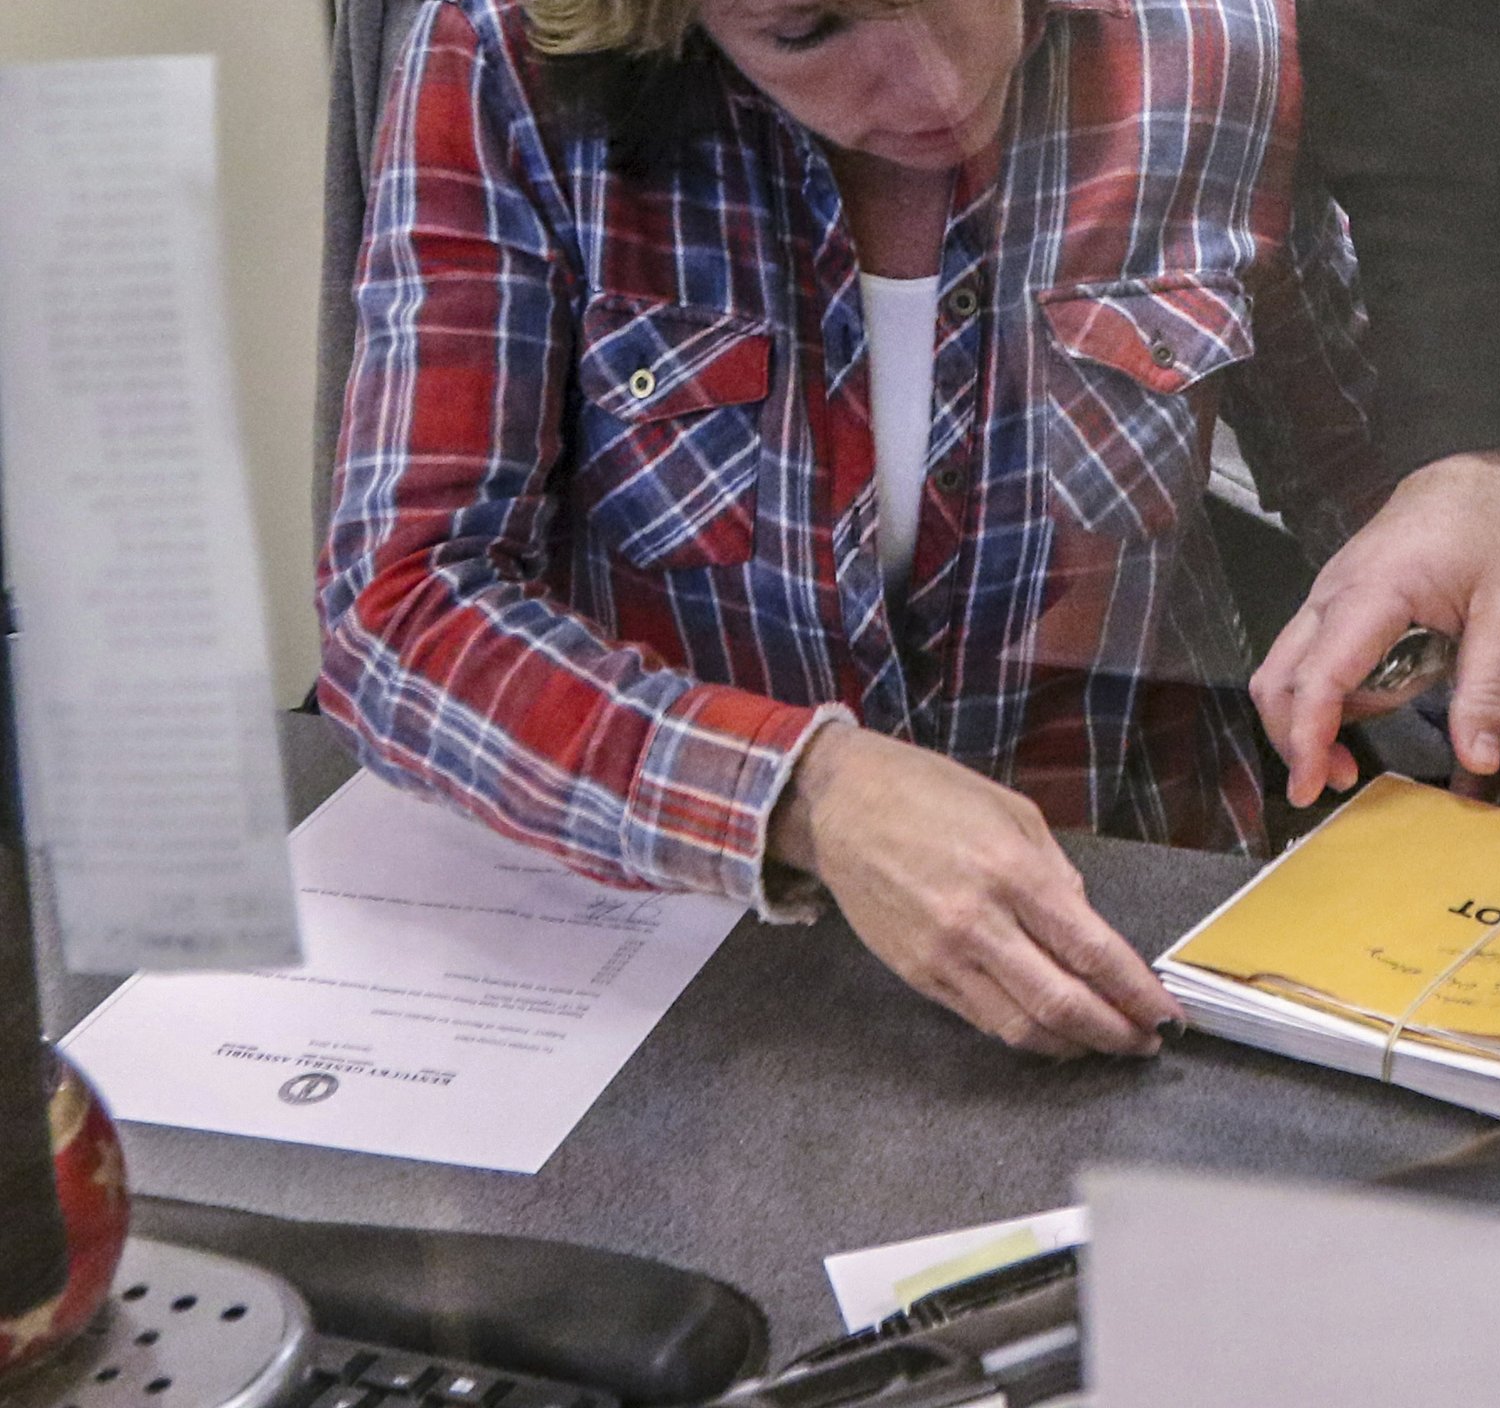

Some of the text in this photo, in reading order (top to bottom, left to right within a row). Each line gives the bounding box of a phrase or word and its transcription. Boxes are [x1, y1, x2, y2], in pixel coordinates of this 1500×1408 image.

[215, 1047, 290, 1065] ASSEMBLY
[296, 1057, 364, 1075] GENERAL
[370, 1068, 455, 1086] KENTUCKY
